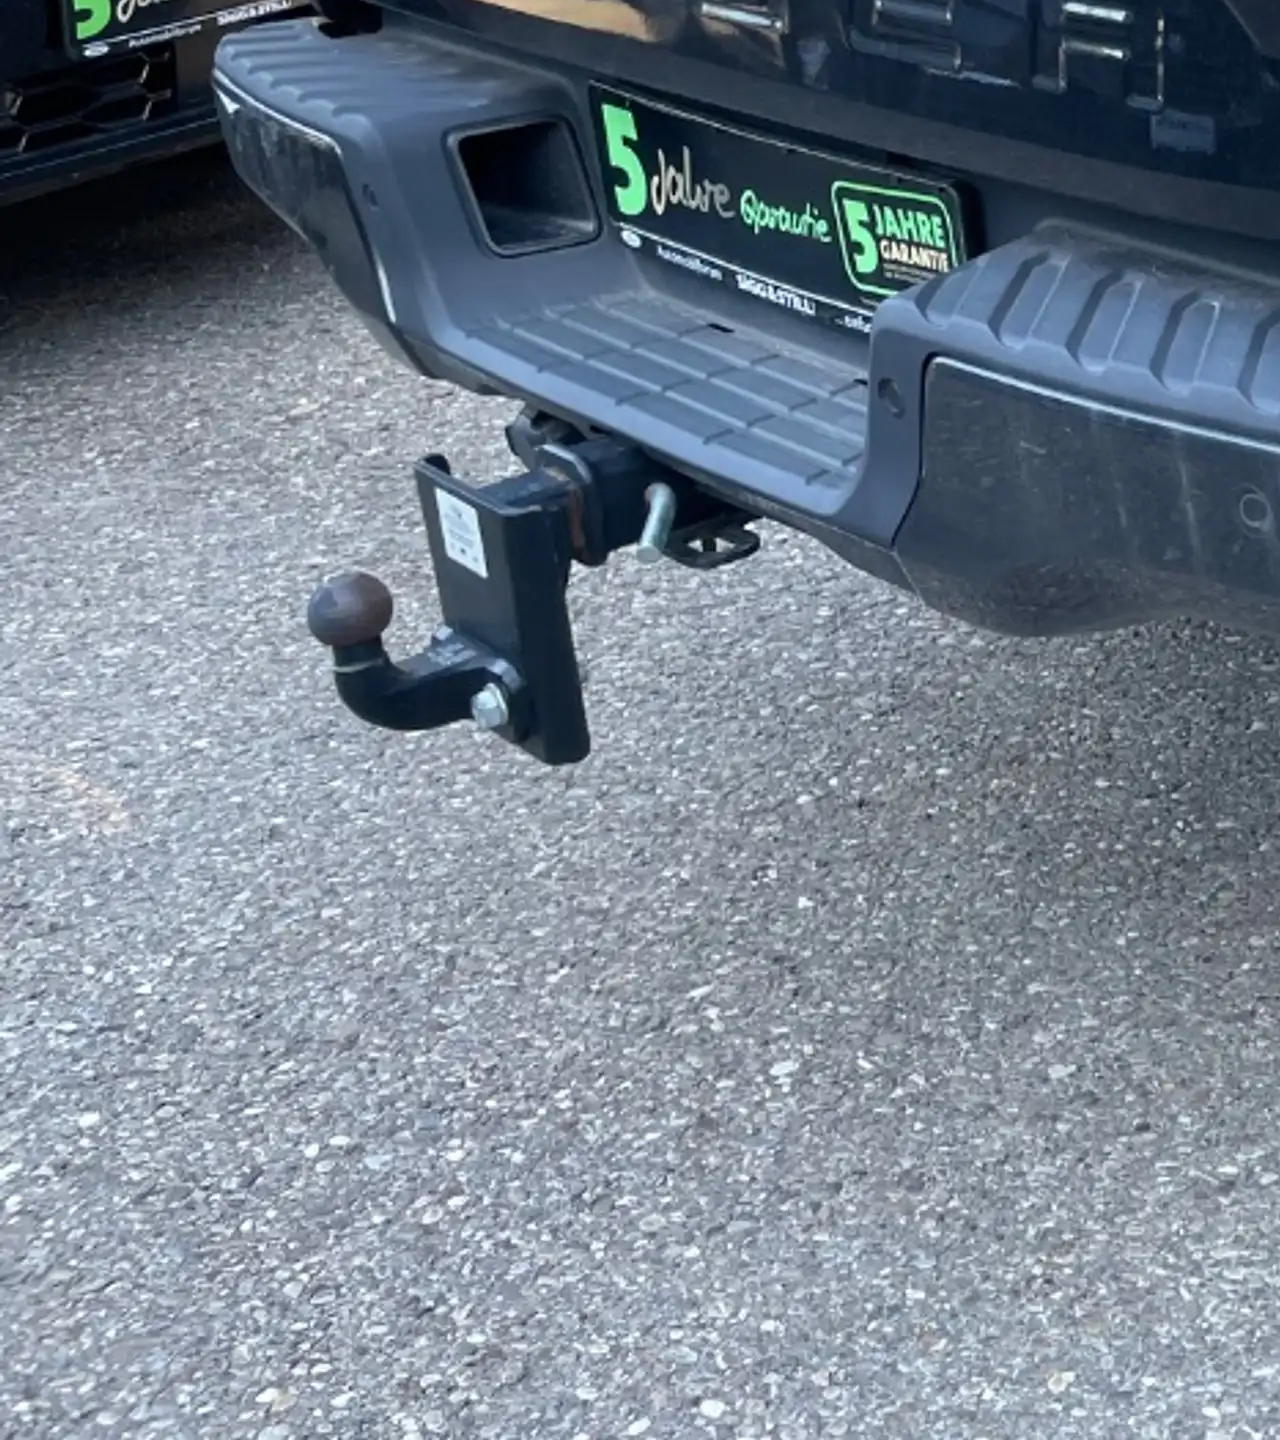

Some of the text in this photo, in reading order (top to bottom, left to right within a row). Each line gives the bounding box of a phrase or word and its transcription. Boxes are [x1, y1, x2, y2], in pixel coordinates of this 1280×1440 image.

[602, 104, 646, 216] 5
[842, 198, 878, 273] 5
[872, 204, 946, 248] JAHRE
